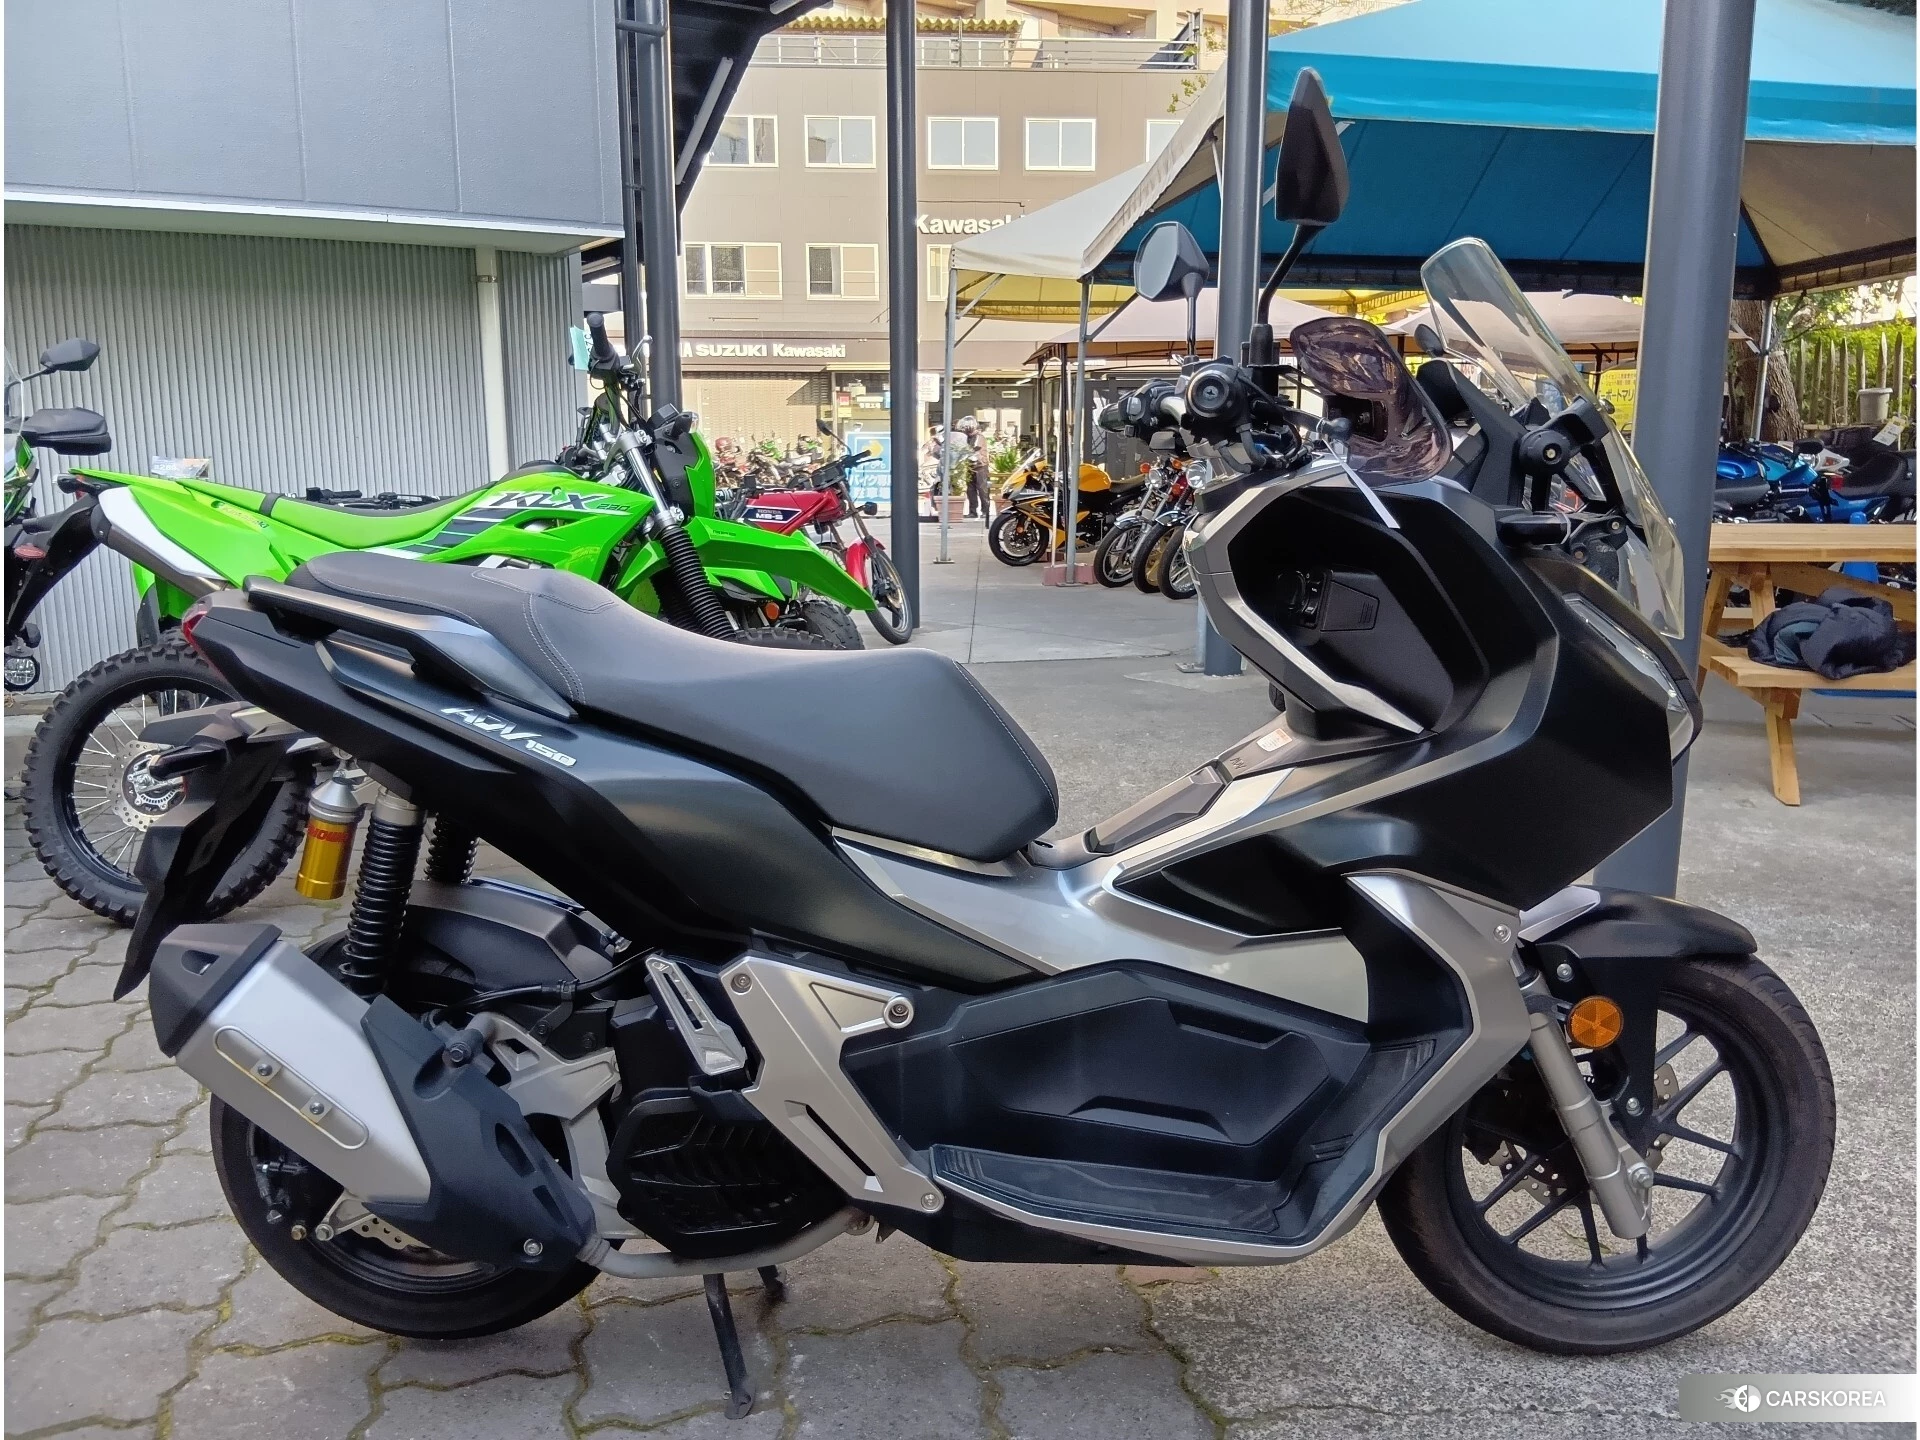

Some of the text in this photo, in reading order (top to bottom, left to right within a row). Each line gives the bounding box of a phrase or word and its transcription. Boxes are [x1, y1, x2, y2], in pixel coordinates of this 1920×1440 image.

[695, 344, 768, 357] SUZUKI
[772, 343, 846, 358] Kawasaki
[488, 491, 631, 513] KLX 230
